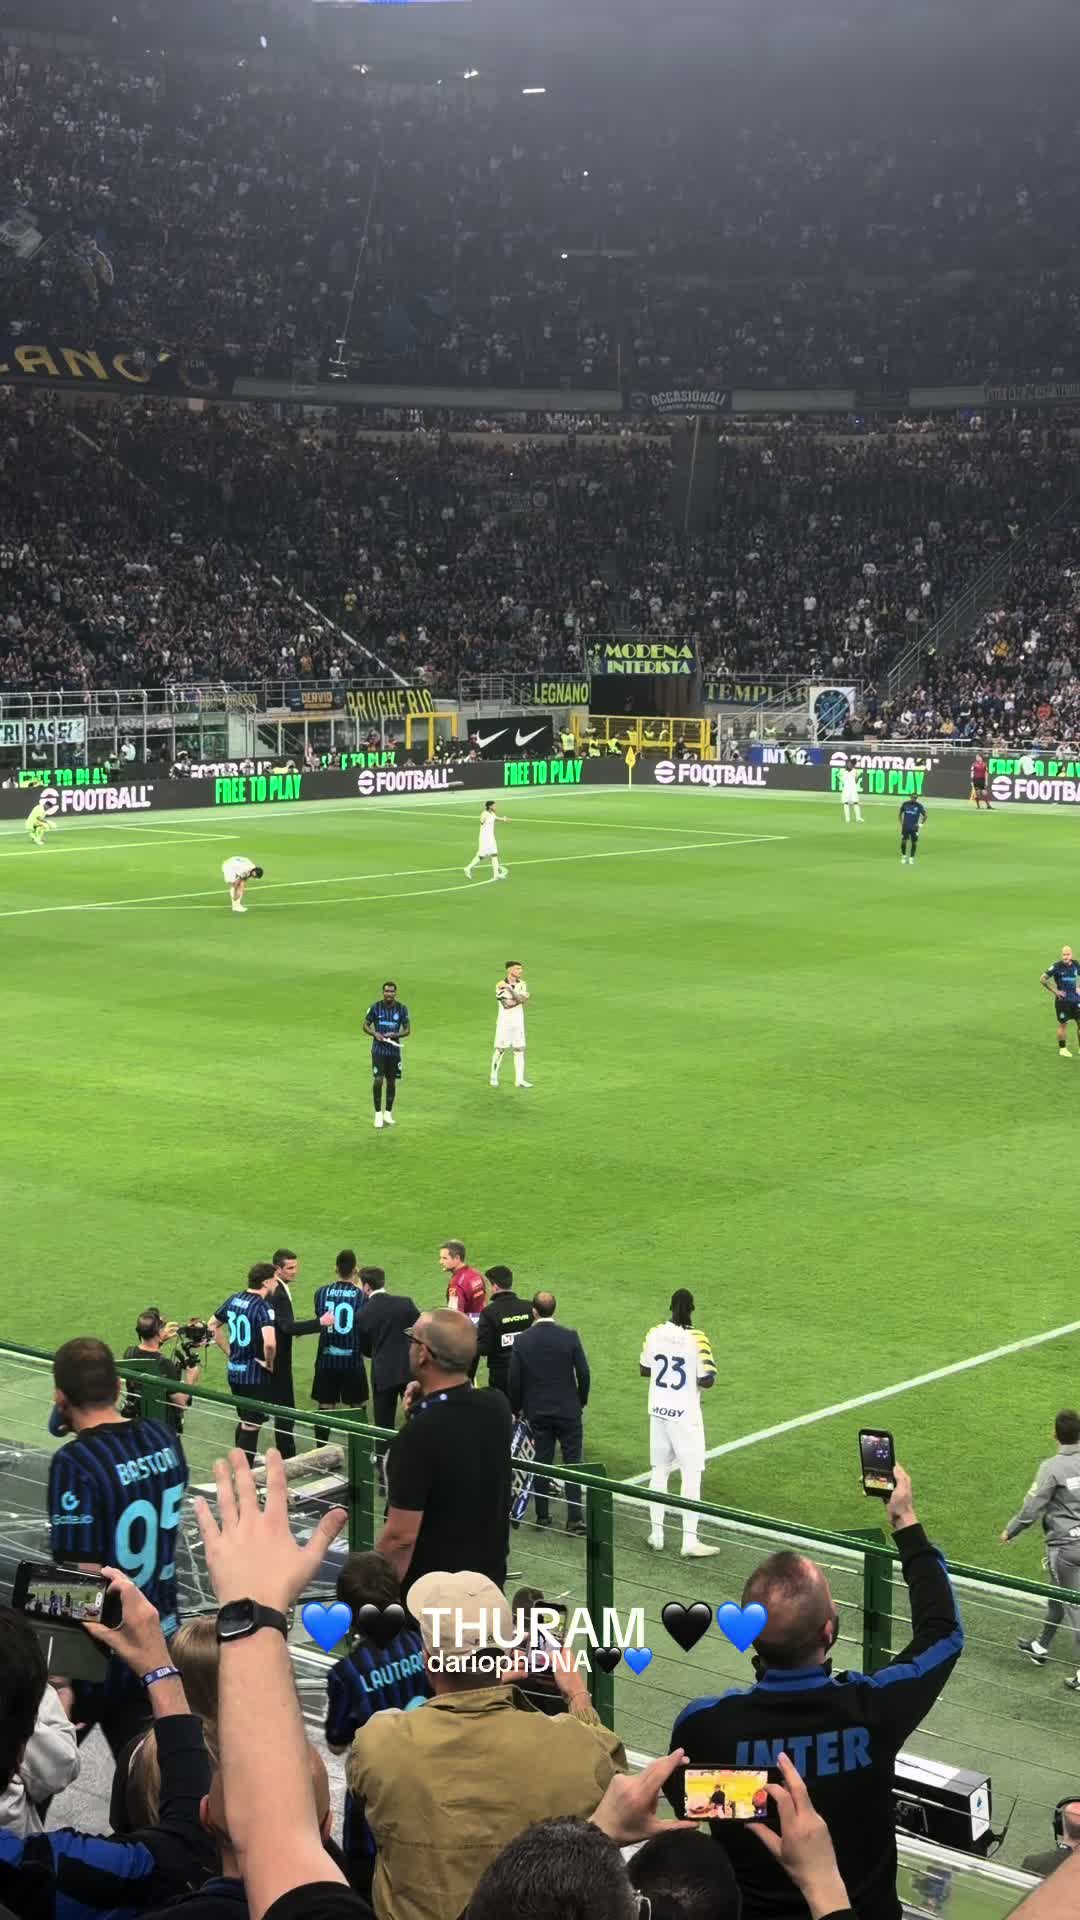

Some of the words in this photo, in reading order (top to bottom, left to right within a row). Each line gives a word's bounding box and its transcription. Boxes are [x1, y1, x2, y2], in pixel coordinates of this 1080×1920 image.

[605, 643, 694, 659] MODENA
[607, 660, 692, 674] INTERISTA
[535, 683, 588, 704] LEGNANO
[376, 770, 449, 793] FOOTBALL
[504, 761, 530, 786] FREE
[532, 761, 547, 784] TO
[550, 760, 583, 784] PLAY
[679, 764, 766, 785] FOOTBALL
[867, 769, 885, 793] TO
[889, 770, 924, 795] PLAY
[62, 786, 151, 812] FOOTBALL
[216, 777, 246, 804] FREE
[249, 776, 267, 802] TO
[270, 774, 302, 801] PLAY
[226, 1311, 251, 1348] 30
[654, 1354, 687, 1391] 23
[736, 1727, 872, 1778] INTER
